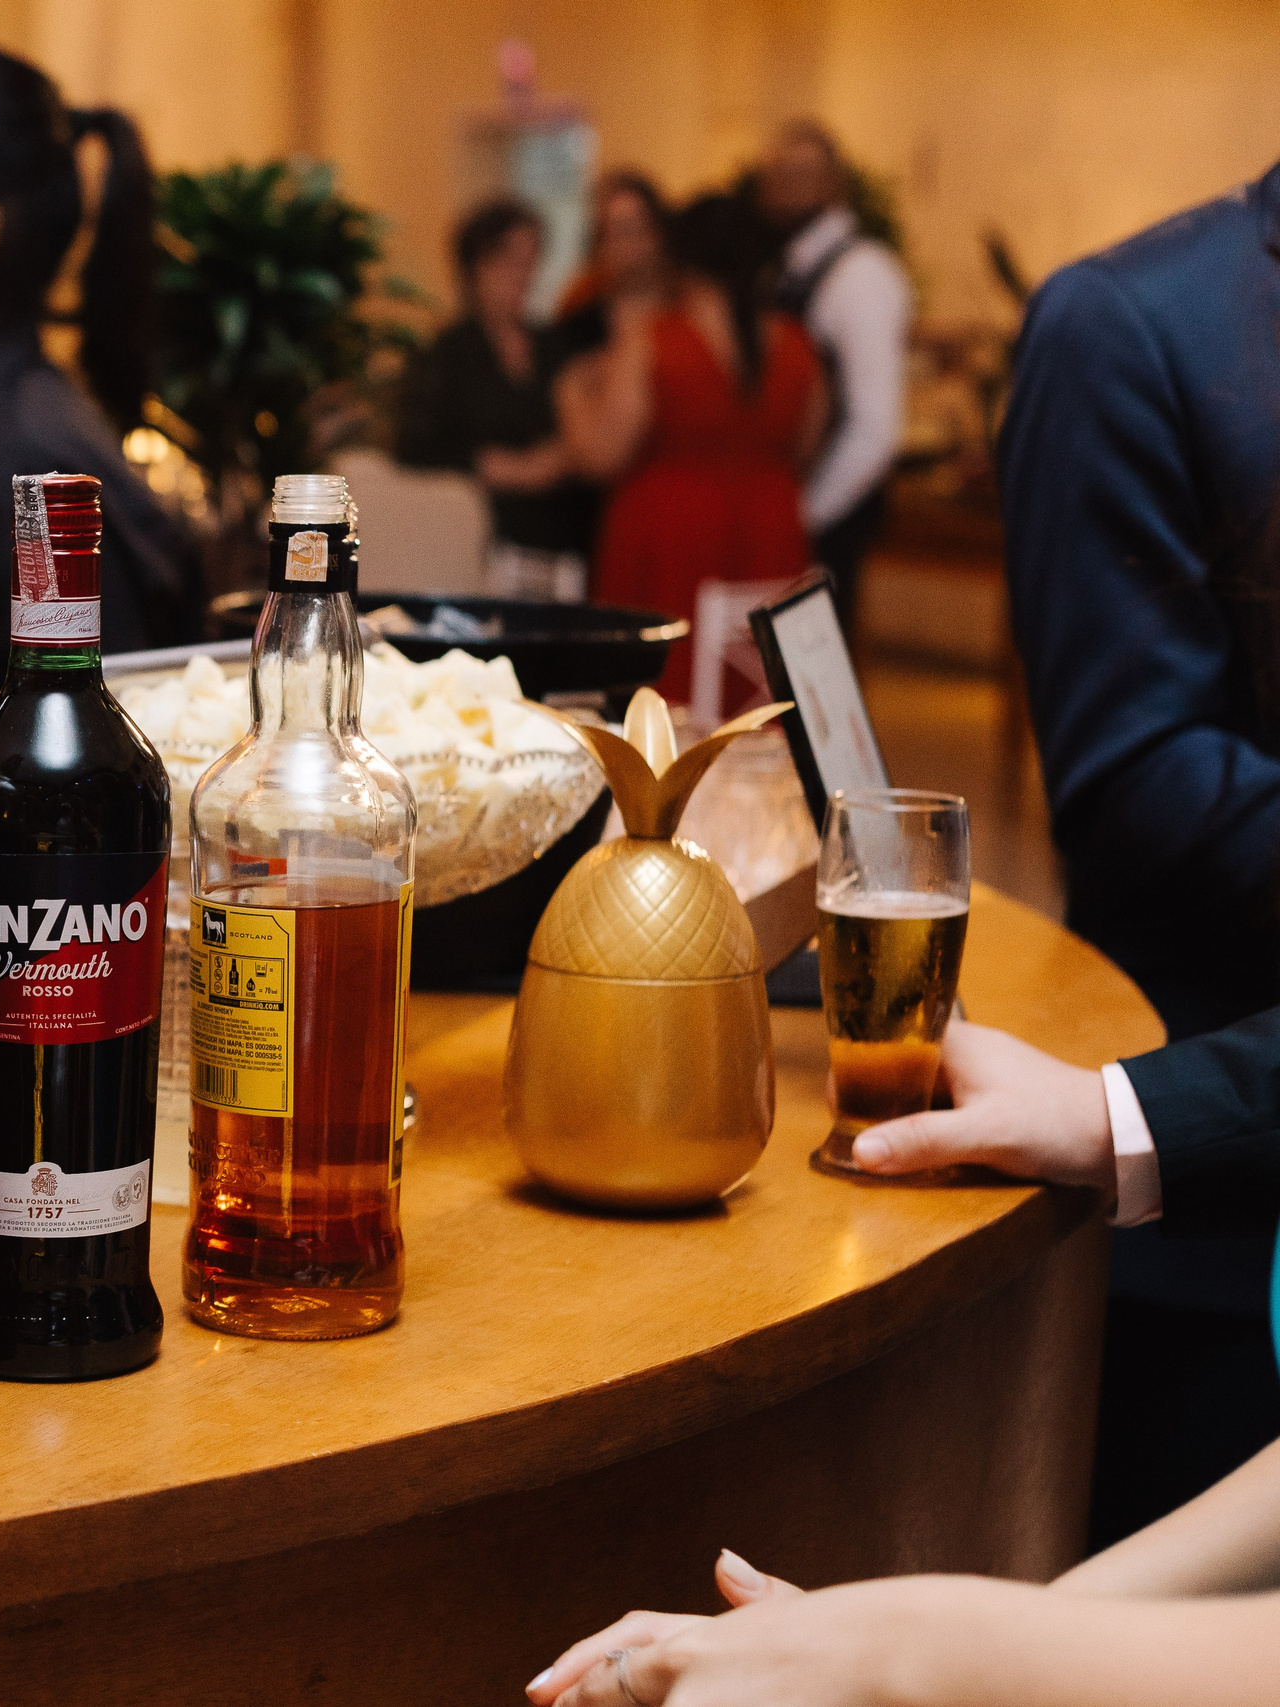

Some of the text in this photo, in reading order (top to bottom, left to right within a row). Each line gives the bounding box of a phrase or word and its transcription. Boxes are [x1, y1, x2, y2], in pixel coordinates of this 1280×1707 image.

[230, 931, 273, 941] SCOTLAND
[22, 985, 74, 998] ROSSO
[5, 1010, 97, 1020] AUTENTICA SPECIALITÀ
[214, 1005, 233, 1015] WHISKY
[28, 1207, 63, 1219] 1757
[3, 1219, 36, 1227] PRODOTTO
[77, 1217, 110, 1226] TRADIZIONE
[66, 1224, 103, 1232] AROMATICHE
